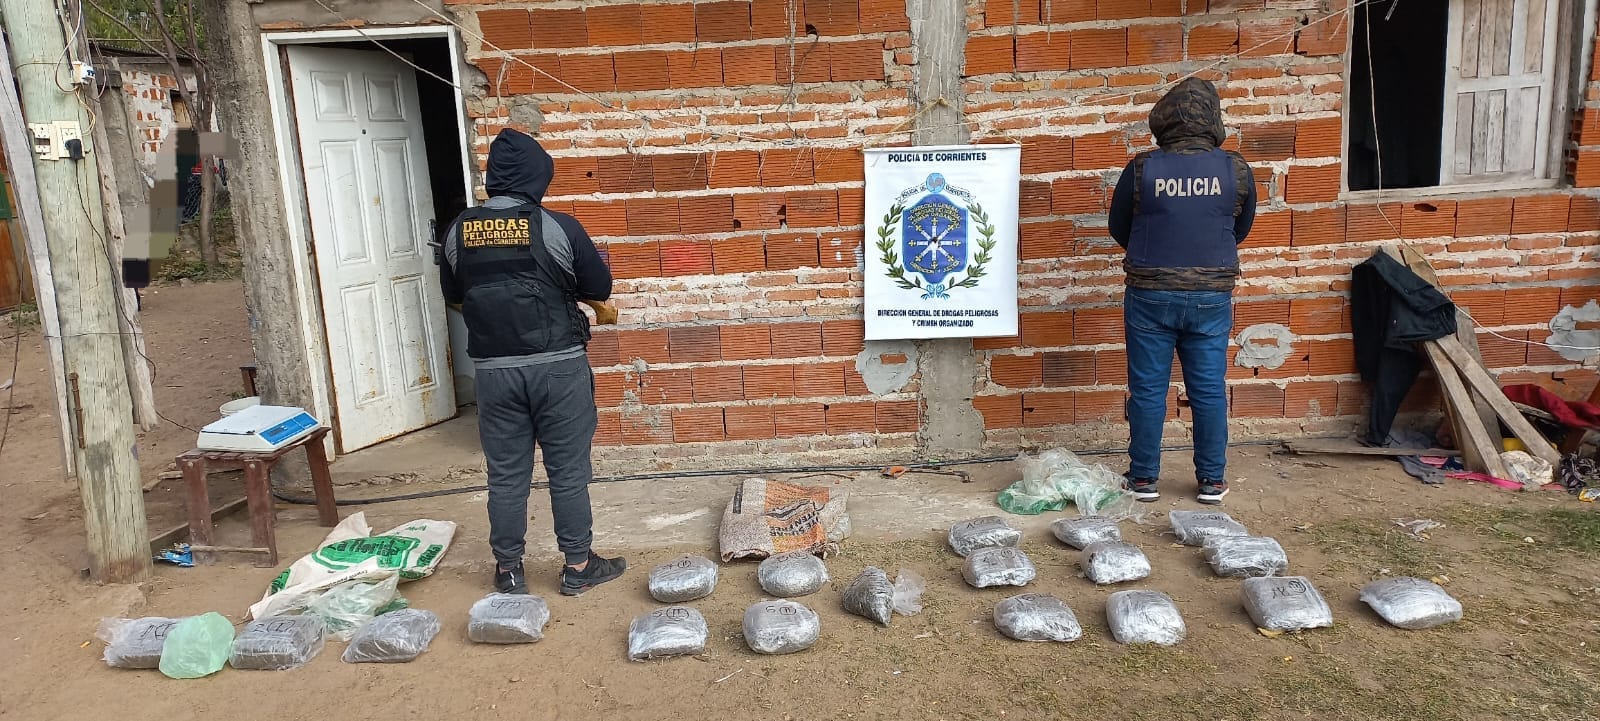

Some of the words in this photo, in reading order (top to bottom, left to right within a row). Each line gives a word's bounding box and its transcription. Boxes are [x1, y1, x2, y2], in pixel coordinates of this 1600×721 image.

[888, 153, 920, 163] POLICIA
[922, 153, 934, 162] DE
[935, 152, 987, 161] CORRIENTES
[1155, 177, 1222, 197] POLICIA
[463, 218, 529, 233] DROGAS
[463, 230, 530, 241] PELIGROSAS
[878, 309, 907, 317] DIRECCION
[907, 309, 932, 317] GENERAL
[933, 309, 941, 317] DE
[941, 309, 964, 317] DROGAS
[964, 309, 999, 317] PELIGROSAS
[912, 319, 916, 327] Y
[916, 319, 938, 327] CRIMEN
[938, 319, 974, 327] ORGANIZADO
